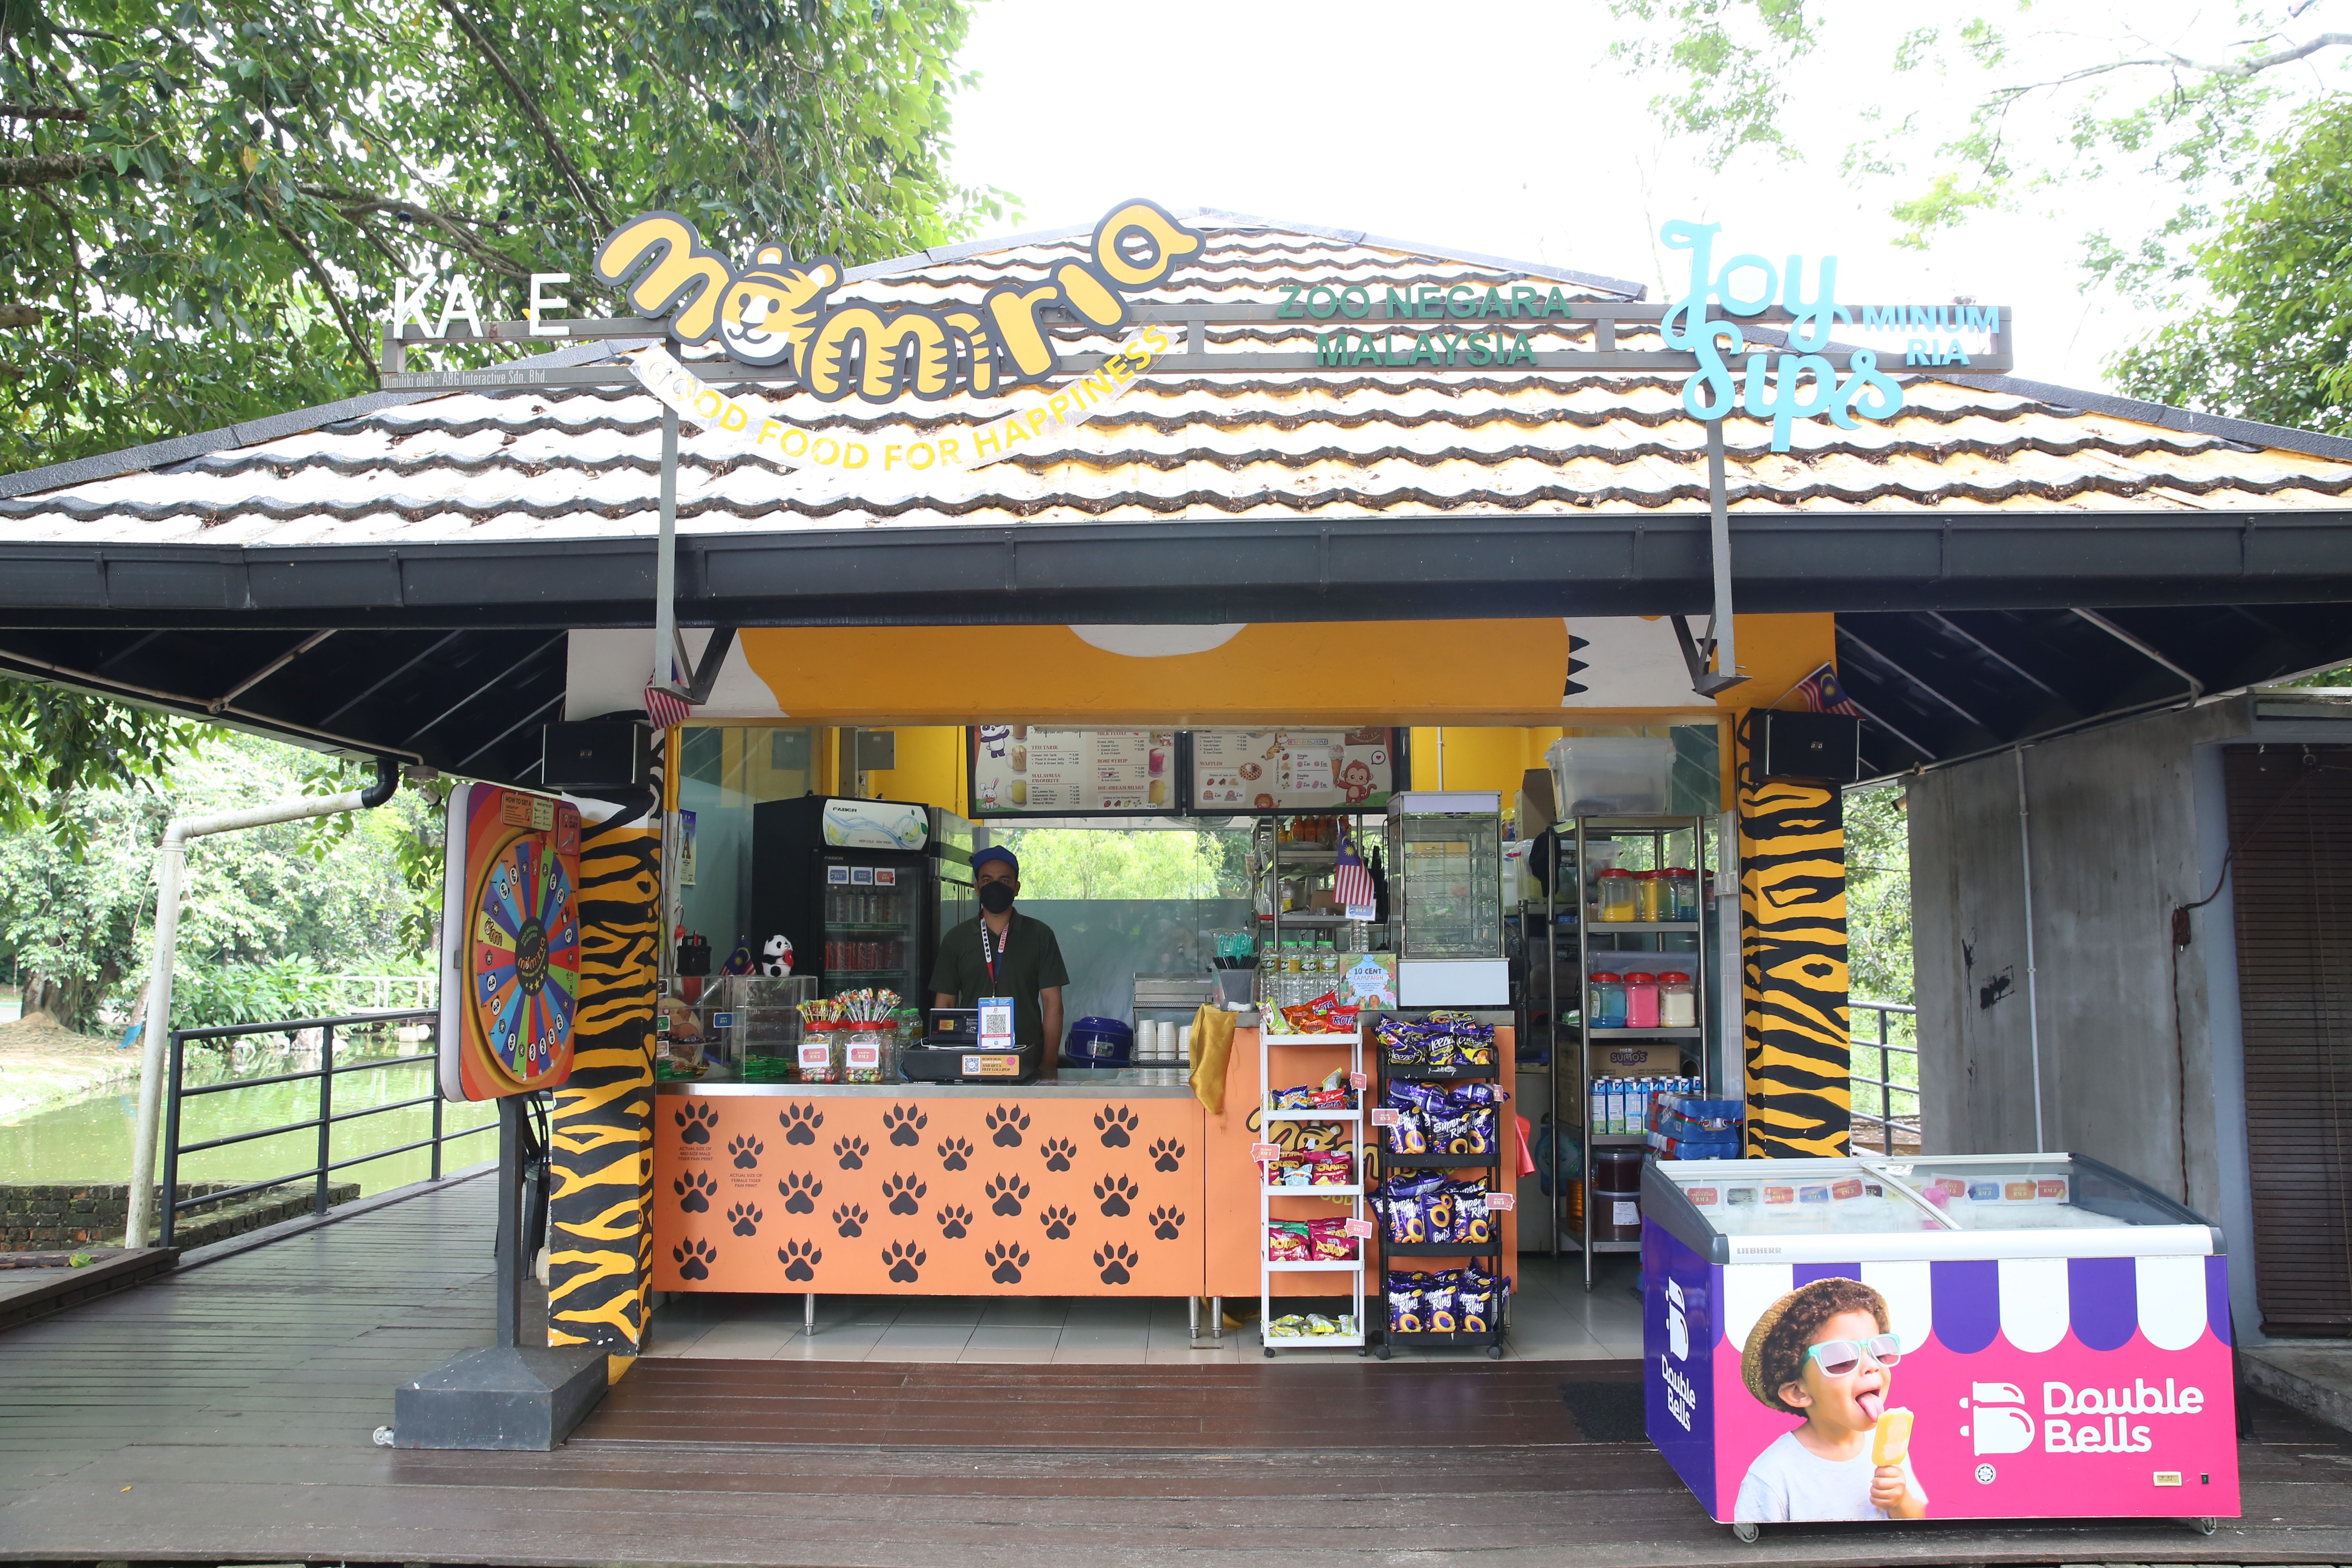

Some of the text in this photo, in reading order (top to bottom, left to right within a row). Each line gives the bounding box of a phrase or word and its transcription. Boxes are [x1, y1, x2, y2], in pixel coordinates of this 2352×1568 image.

[1661, 220, 1853, 354] Joy
[1277, 285, 1573, 320] ZOO NEGARA
[1863, 305, 1999, 334] MINUM
[1316, 332, 1539, 367] MALAYSIA
[1907, 338, 1971, 367] RIA
[384, 375, 413, 388] Dimiliki
[416, 374, 434, 387] oleh
[443, 373, 459, 385] ABG
[463, 372, 506, 385] Interactive
[509, 371, 526, 383] Sdn.
[530, 370, 548, 383] Bhd.
[1683, 321, 1904, 452] Sips
[643, 323, 1170, 471] GOOD FOOD FOR HAPPINESS
[569, 821, 578, 829] DAY
[1332, 1015, 1355, 1026] ROTA
[1433, 1117, 1461, 1133] Super
[1450, 1123, 1468, 1138] Ring
[1455, 1199, 1482, 1211] Super
[1471, 1206, 1489, 1218] Ring
[1737, 1246, 1782, 1254] LIEBHERR
[1425, 1288, 1445, 1301] uper
[1432, 1294, 1452, 1310] Ring
[1459, 1292, 1479, 1303] uper
[1399, 1298, 1418, 1313] Ring
[1466, 1302, 1484, 1314] Ring
[1662, 1354, 1696, 1411] Double
[2043, 1377, 2204, 1414] Double
[1667, 1385, 1691, 1432] Bells
[2044, 1417, 2152, 1453] Bells
